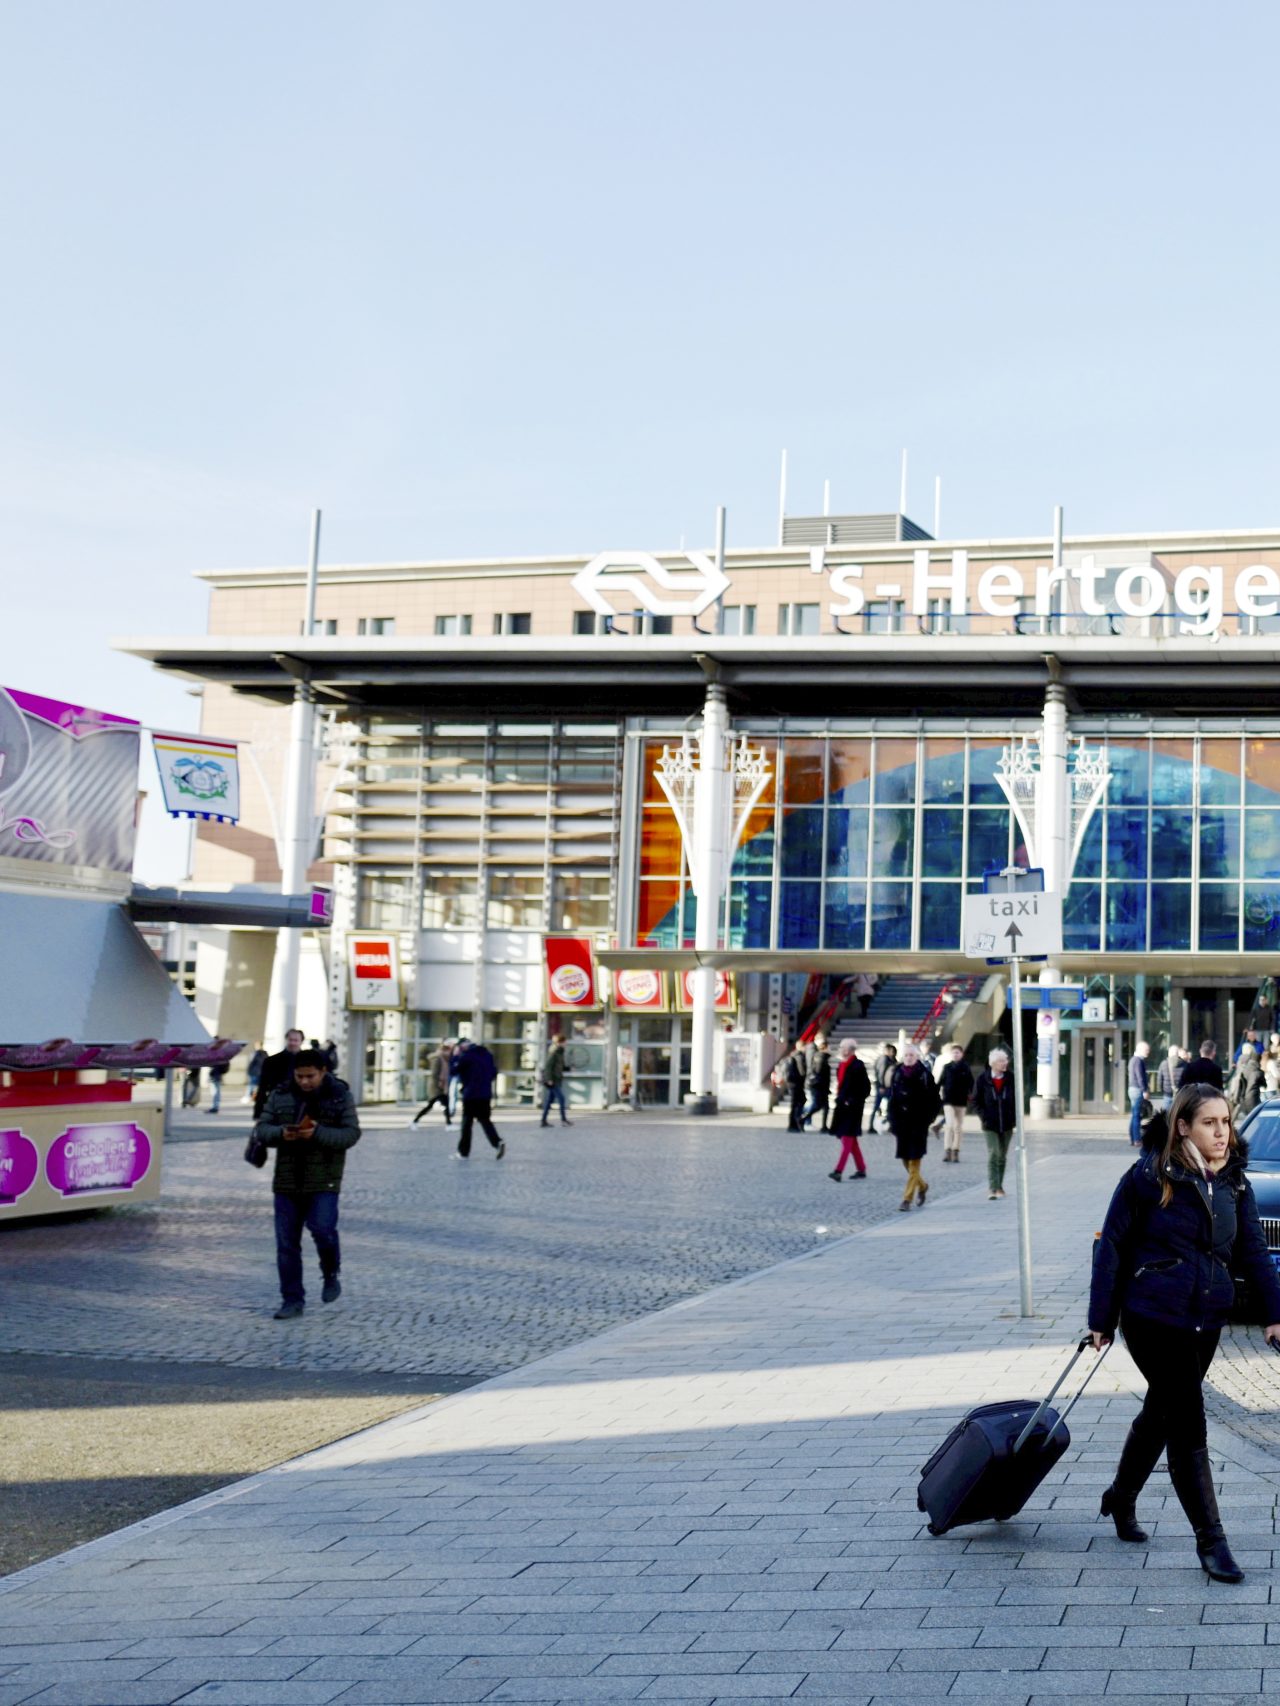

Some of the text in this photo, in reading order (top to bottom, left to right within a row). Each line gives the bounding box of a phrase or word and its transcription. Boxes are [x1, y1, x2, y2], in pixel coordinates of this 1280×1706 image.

[989, 895, 1038, 917] taxi
[354, 953, 391, 967] HEMA
[560, 980, 586, 991] KING
[64, 1138, 137, 1158] Oliebollen &
